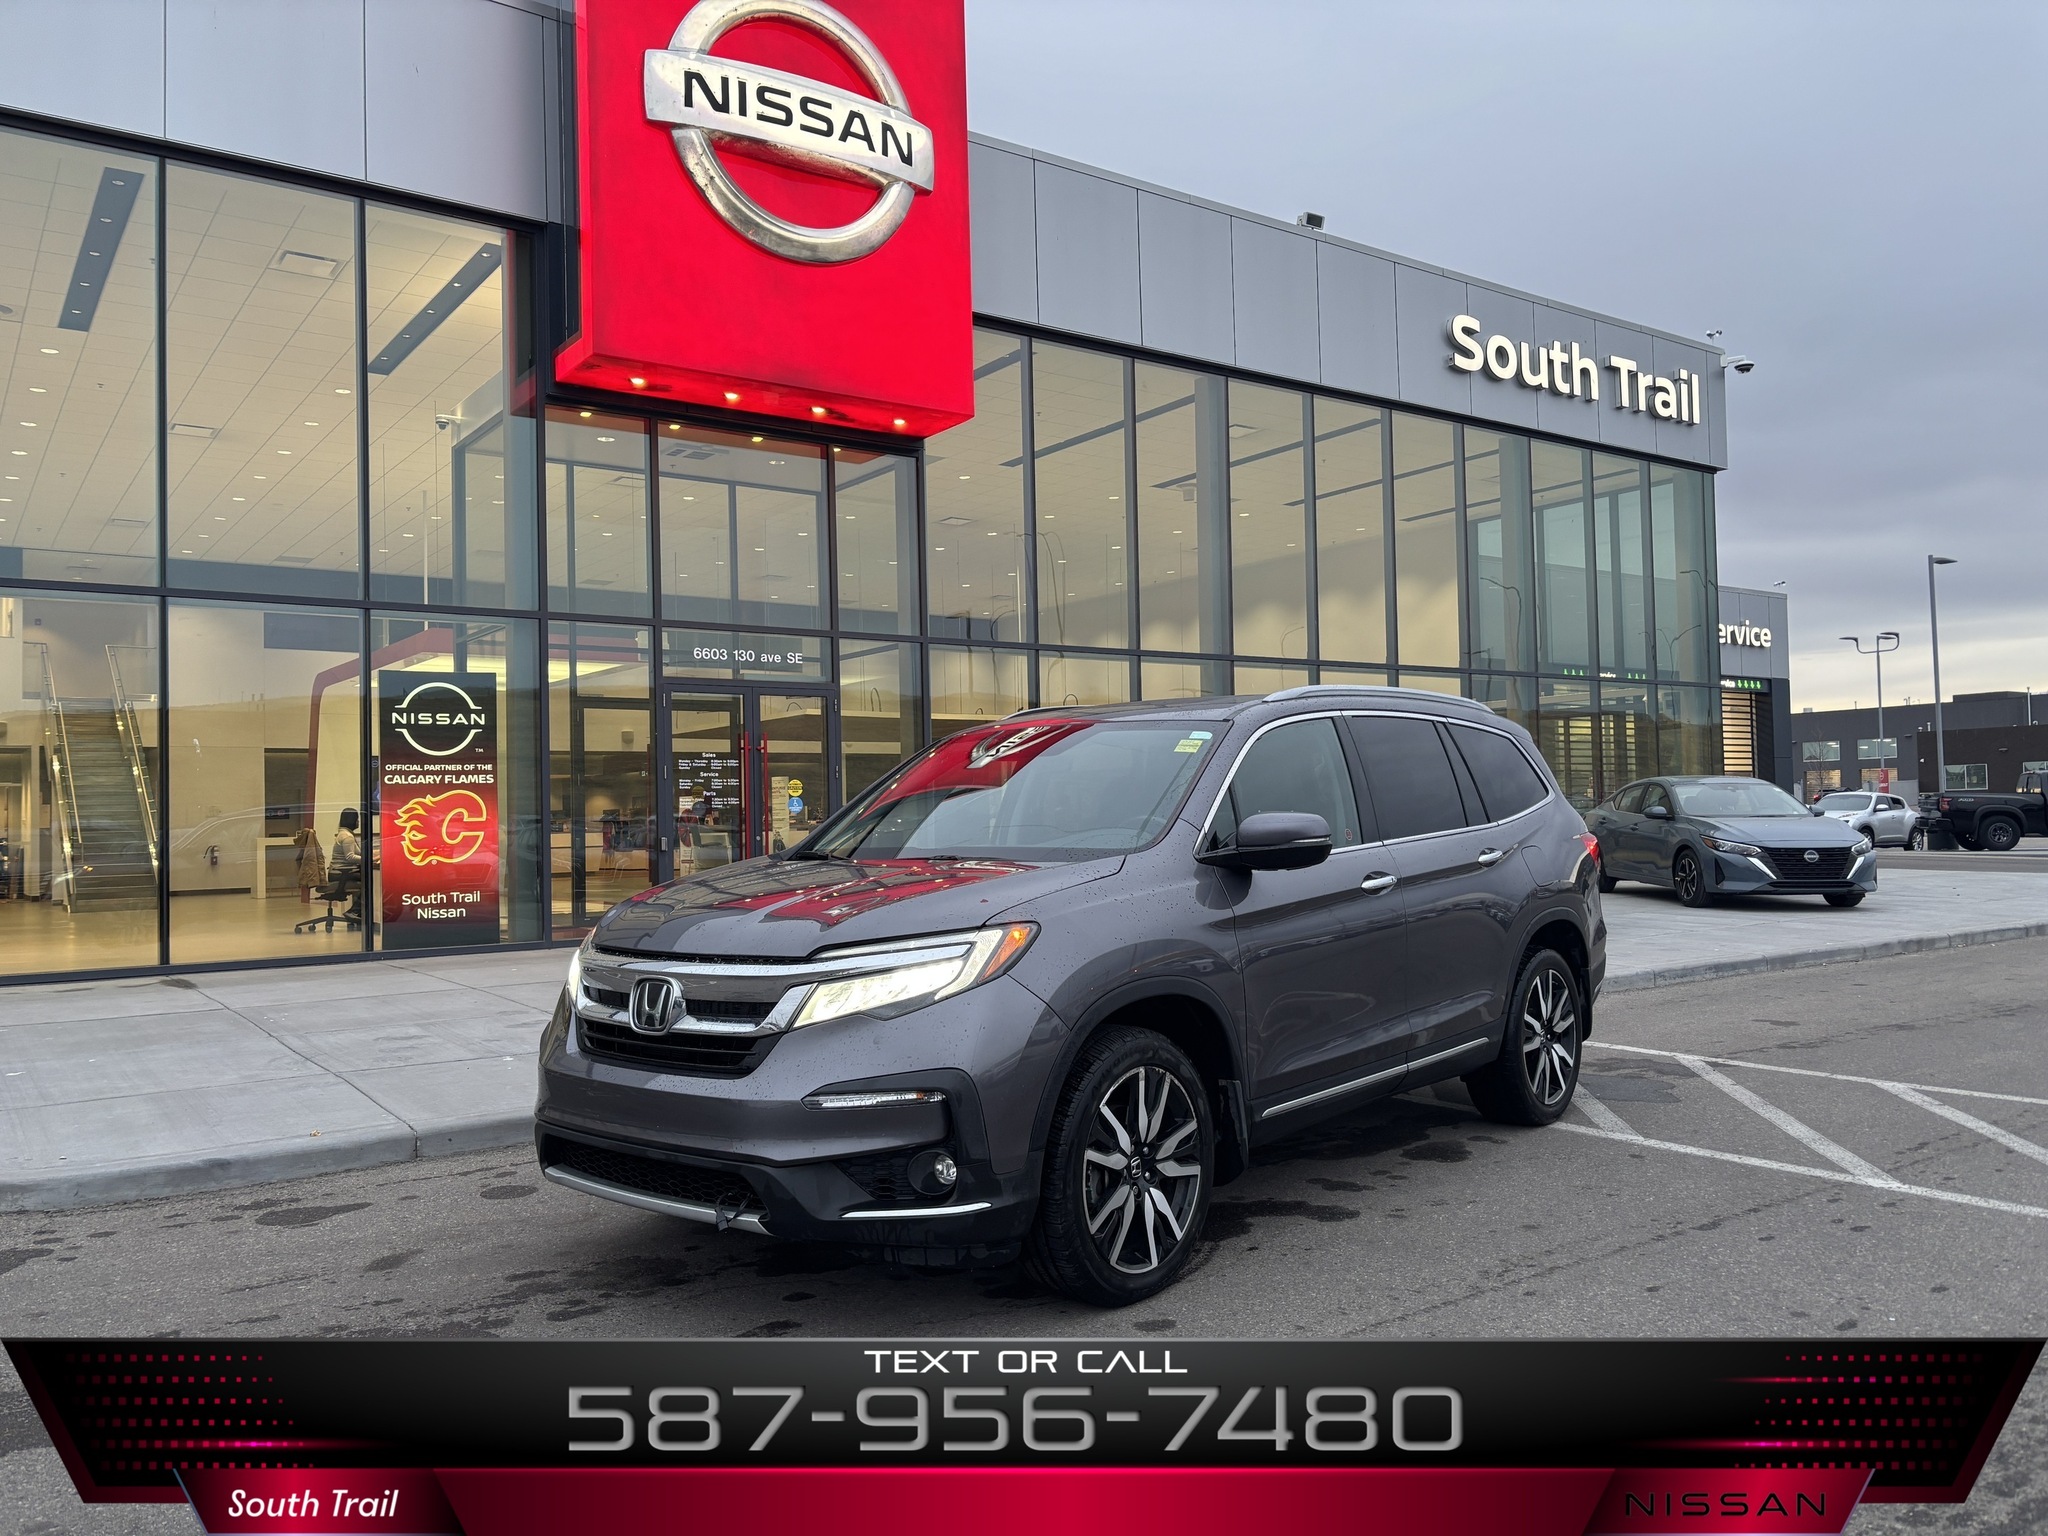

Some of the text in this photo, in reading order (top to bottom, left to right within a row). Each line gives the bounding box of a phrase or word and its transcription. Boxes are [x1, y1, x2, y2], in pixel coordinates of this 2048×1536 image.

[684, 70, 914, 168] NISSAN
[1450, 314, 1701, 426] South Trail
[1719, 619, 1772, 648] ervice
[693, 647, 803, 664] 6603 130 ave SE
[391, 712, 486, 726] NISSAN
[384, 774, 494, 784] CALGARY FLAMES
[402, 891, 481, 906] South Trail
[417, 907, 466, 920] Nissan
